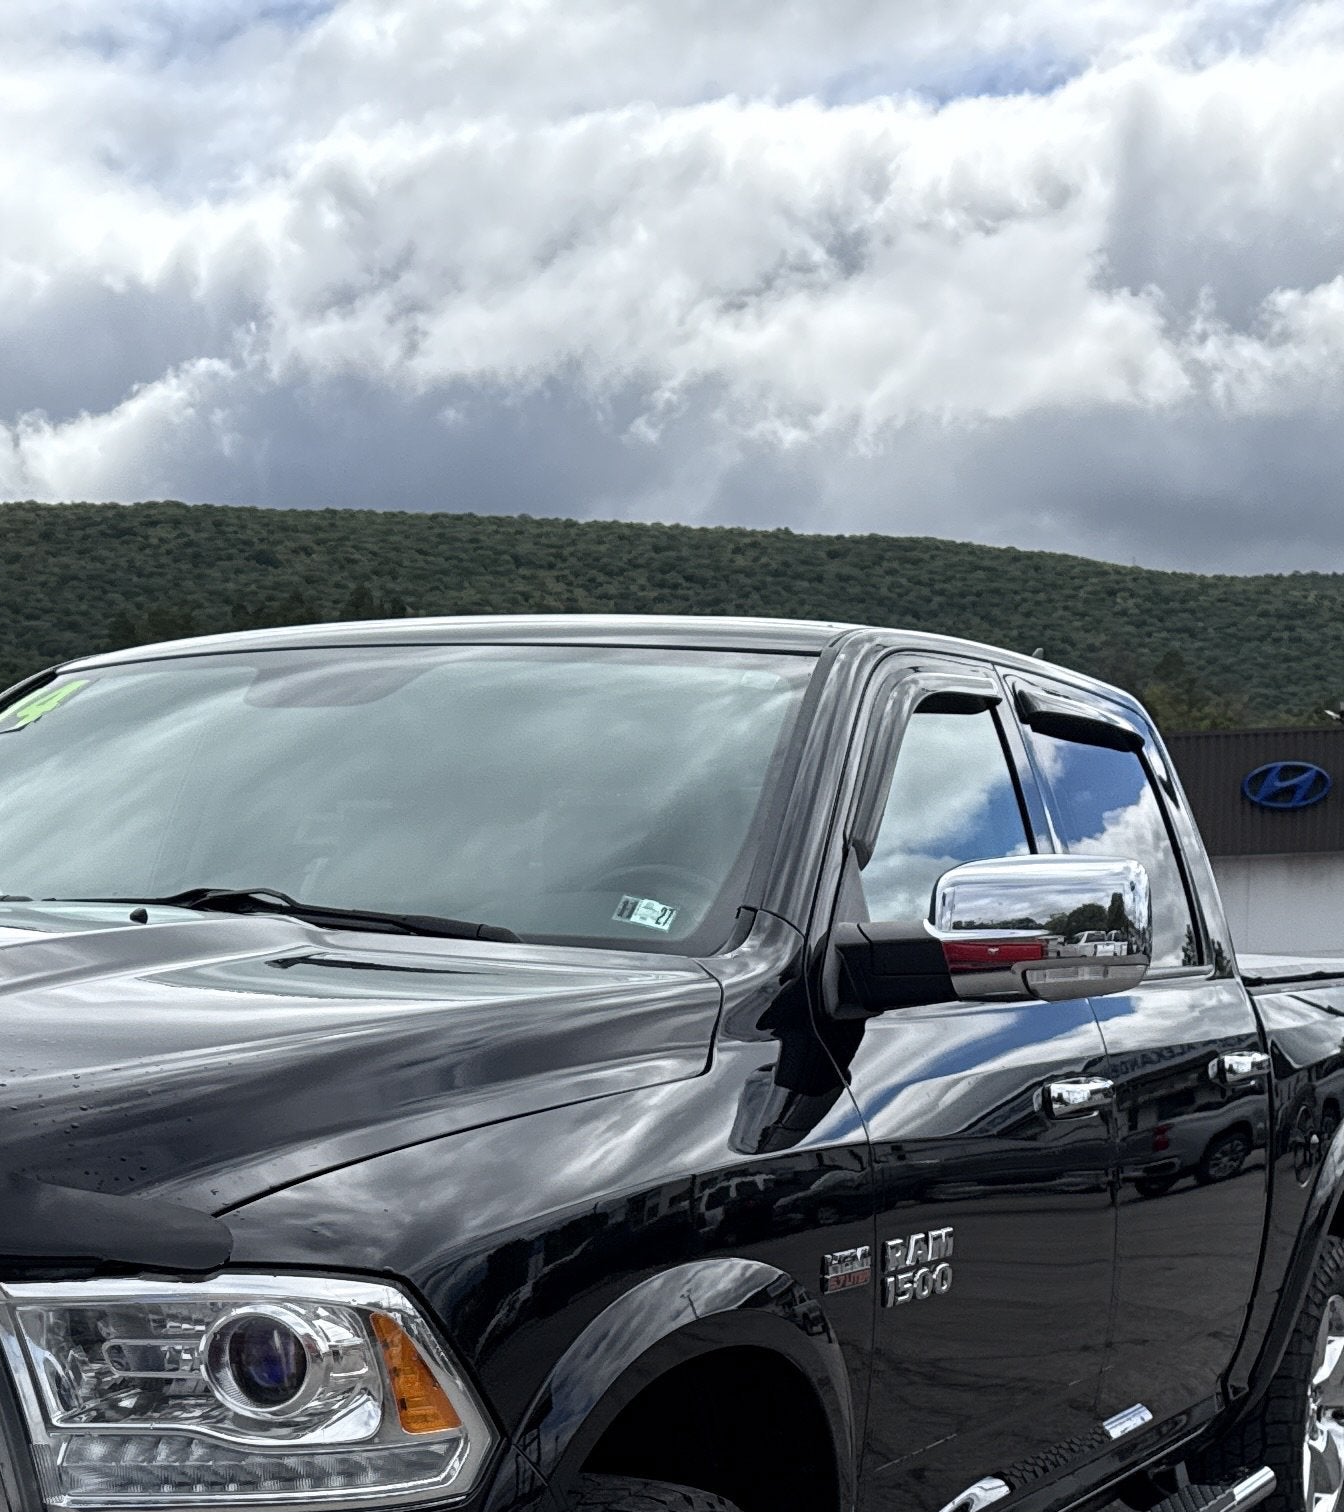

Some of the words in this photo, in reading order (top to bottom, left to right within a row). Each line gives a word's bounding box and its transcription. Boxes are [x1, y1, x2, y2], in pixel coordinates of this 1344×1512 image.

[655, 906, 676, 926] 27
[883, 1226, 954, 1272] RAM
[883, 1261, 953, 1308] 1500
